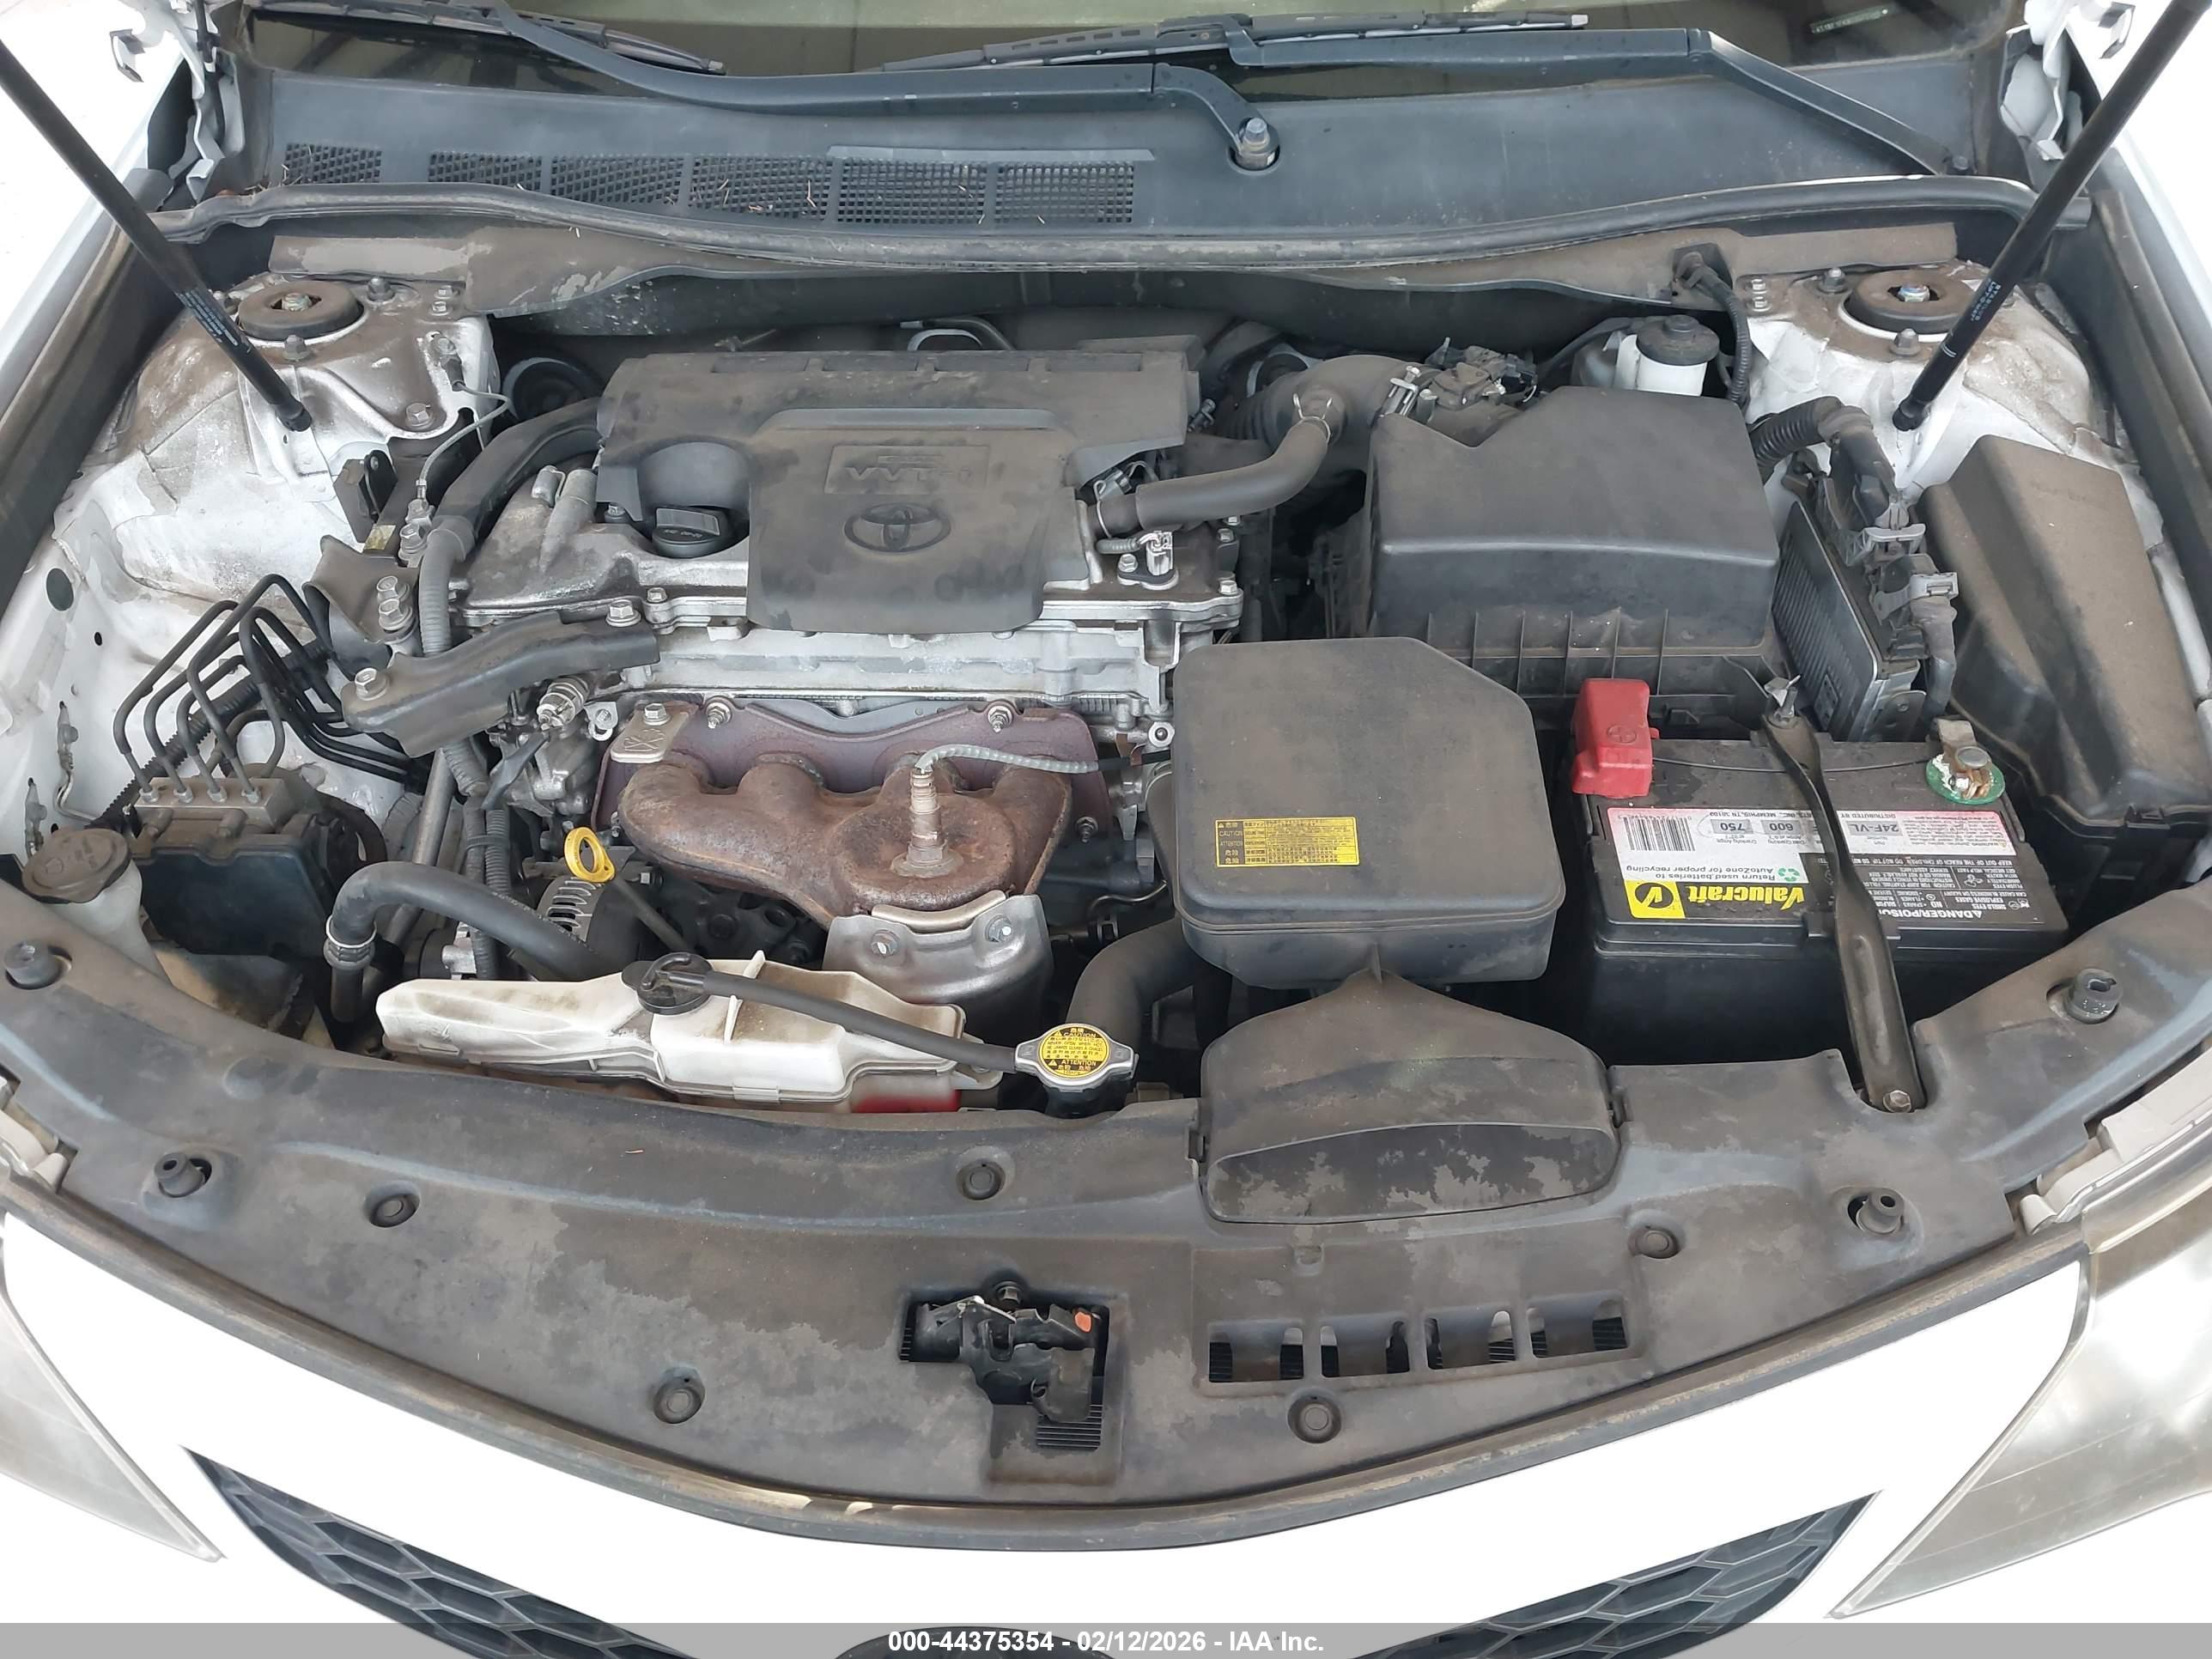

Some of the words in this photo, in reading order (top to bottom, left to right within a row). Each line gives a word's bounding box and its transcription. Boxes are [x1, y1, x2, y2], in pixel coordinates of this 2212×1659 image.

[1720, 823, 1746, 831] 750
[1769, 823, 1793, 831] 600
[1688, 885, 1805, 911] Valucraft
